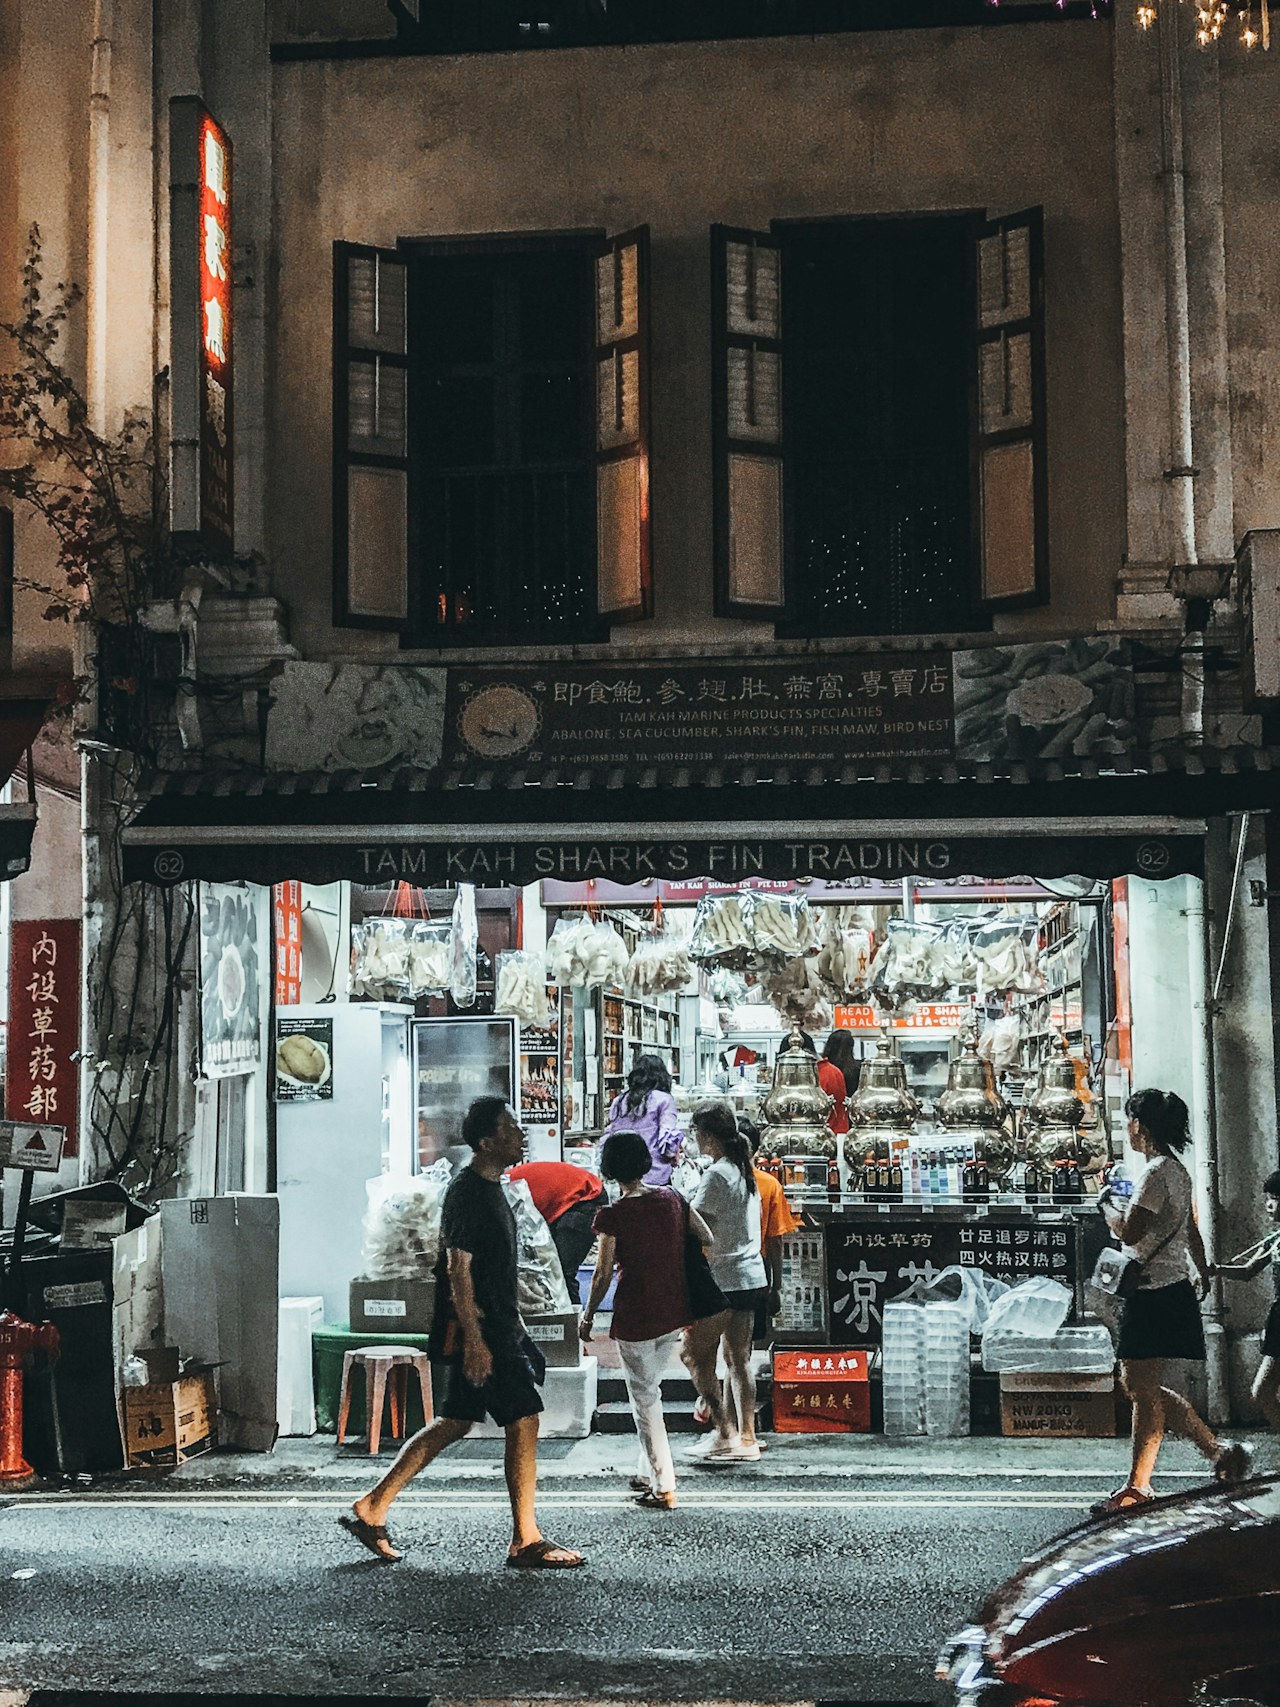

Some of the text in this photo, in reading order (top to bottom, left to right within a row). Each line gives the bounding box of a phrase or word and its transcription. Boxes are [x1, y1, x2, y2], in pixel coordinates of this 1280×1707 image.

[619, 705, 883, 723] TAM KAH MARINE PRODUCTS SPECIALTIES
[619, 728, 643, 740] SEA
[645, 726, 723, 740] CUCUMBER,
[725, 725, 780, 737] SHARK'S
[783, 725, 809, 738] FIN,
[812, 724, 840, 736] FISH
[843, 723, 881, 736] MAW,
[884, 721, 915, 734] BIRD
[917, 719, 950, 731] NEST
[158, 856, 180, 873] 62
[357, 848, 426, 874] TAM
[446, 846, 515, 873] KAH
[708, 845, 763, 871] FIN
[784, 842, 950, 870] TRADING
[1141, 848, 1165, 866] 62
[669, 882, 686, 890] TAM
[687, 882, 703, 890] KAH
[757, 881, 772, 889] PTE
[773, 880, 788, 888] LTD
[934, 1006, 965, 1016] SHAR
[23, 930, 59, 1120] 内设草药部
[843, 1232, 934, 1249] 内设草药
